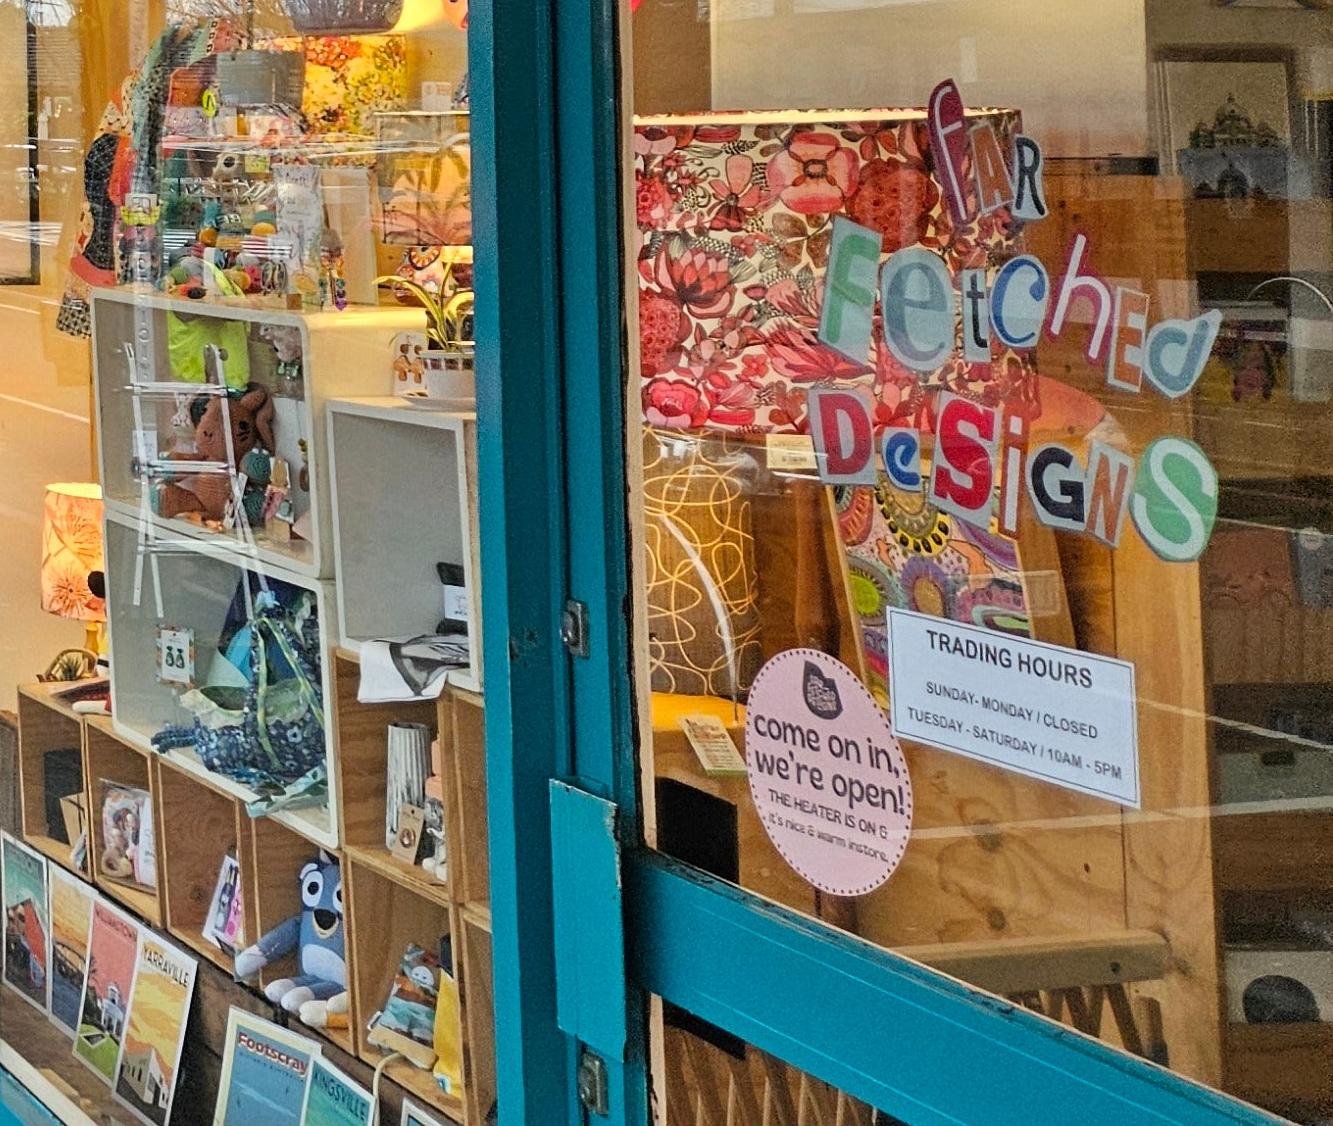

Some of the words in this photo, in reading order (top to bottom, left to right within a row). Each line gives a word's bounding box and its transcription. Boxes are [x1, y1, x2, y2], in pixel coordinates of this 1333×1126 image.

[926, 629, 1013, 669] TRADING
[1017, 652, 1093, 689] HOURS
[907, 706, 963, 734] TUESDAY
[972, 727, 1037, 758] SATURDAY
[1047, 747, 1083, 769] 10AM
[1093, 760, 1123, 780] 5PM
[981, 695, 1034, 723] MONDAY
[1043, 712, 1099, 740] CLOSED
[753, 713, 821, 753] come
[828, 734, 862, 765] on
[866, 736, 901, 779] in,
[755, 749, 825, 791] we're
[831, 773, 906, 816] open!
[767, 788, 792, 808] THE
[794, 796, 842, 824] HEATER
[844, 812, 857, 829] IS
[858, 819, 877, 837] ON
[142, 945, 191, 989] YARRAVILLE
[237, 1031, 310, 1078] Footscray
